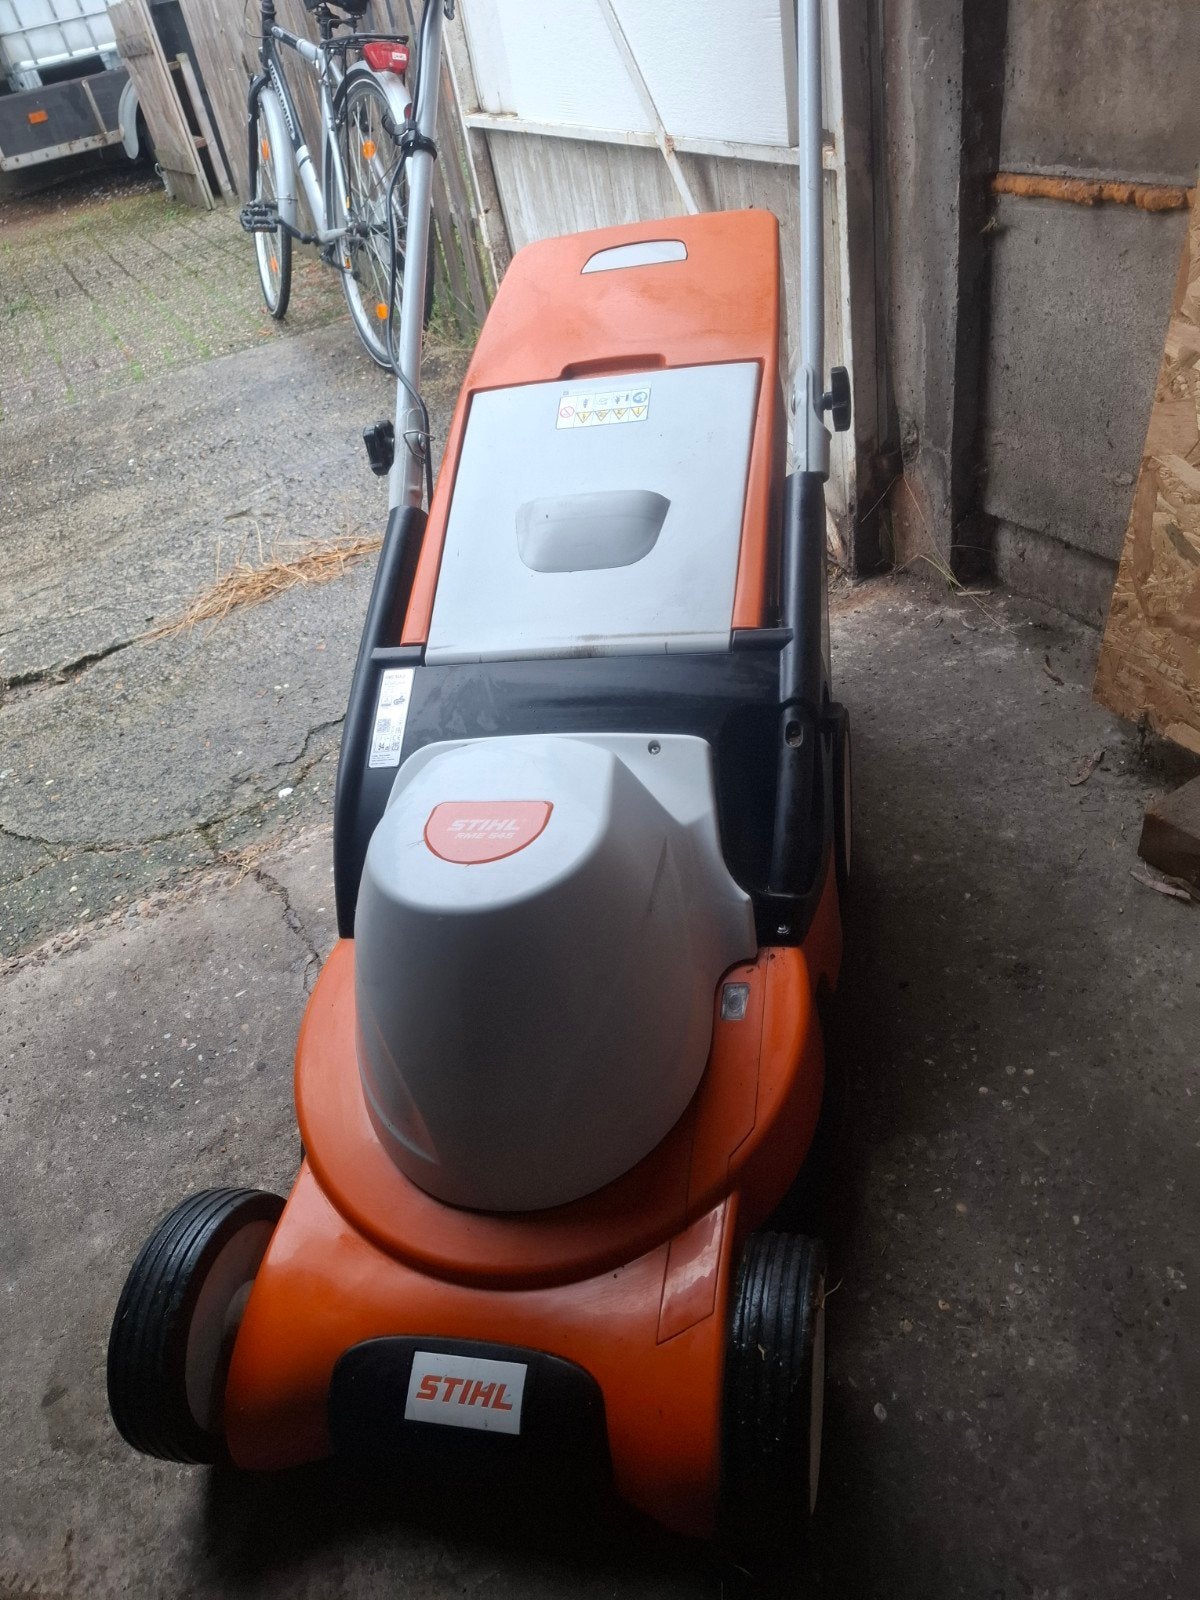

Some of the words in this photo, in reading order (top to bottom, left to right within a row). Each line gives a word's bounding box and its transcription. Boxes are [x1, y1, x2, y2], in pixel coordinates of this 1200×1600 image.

[447, 819, 520, 832] STIHL
[455, 832, 487, 840] RME
[415, 1374, 513, 1411] STIHL
